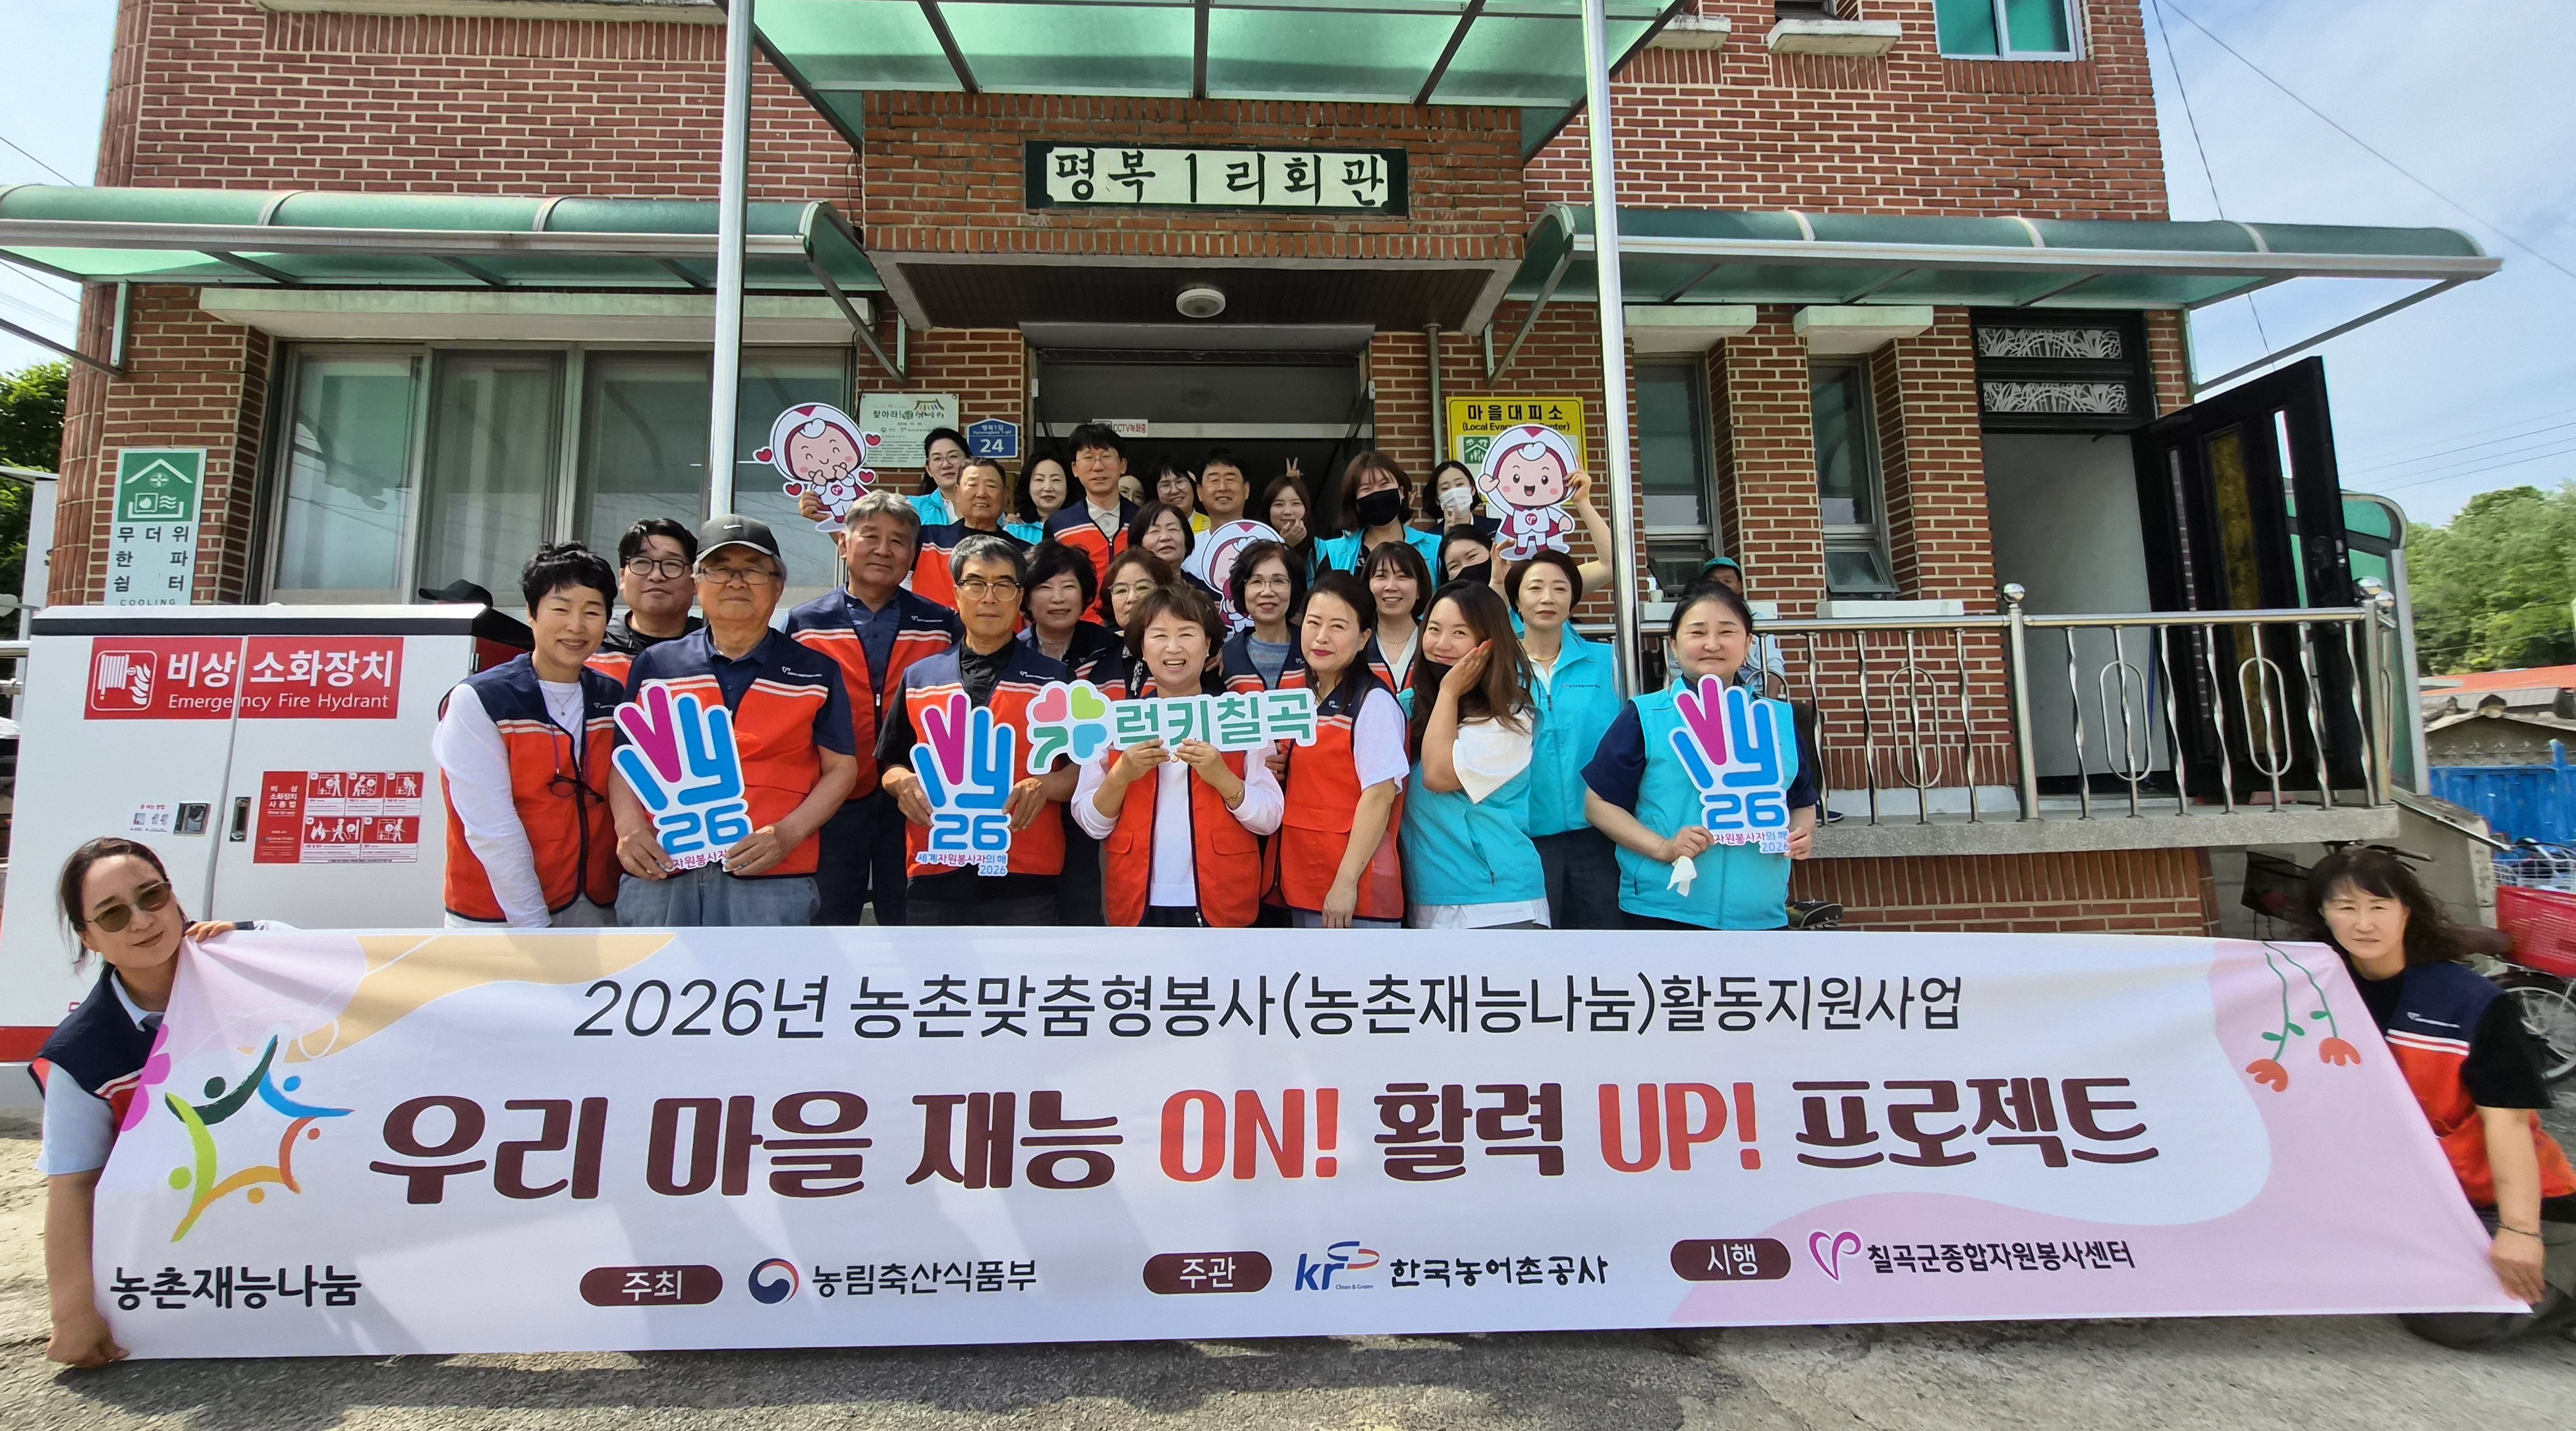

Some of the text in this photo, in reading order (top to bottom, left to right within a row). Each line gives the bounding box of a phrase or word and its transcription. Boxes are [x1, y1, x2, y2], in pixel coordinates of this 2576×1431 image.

[872, 410, 901, 419] 찾아라!
[1462, 422, 1488, 432] (Local
[1467, 404, 1563, 421] 마을대피소
[980, 438, 1004, 453] 24
[117, 526, 189, 543] 무더위
[115, 550, 188, 567] 한파
[113, 575, 184, 592] 쉼터
[167, 650, 393, 688] 비상 소화장치
[169, 692, 389, 712] Emergency Fire Hydrant
[1115, 693, 1312, 746] 럭키칠곡
[1704, 791, 1785, 830] 26
[659, 803, 749, 855] 26
[933, 814, 1008, 851] 26
[997, 855, 1007, 864] 해
[1762, 842, 1789, 852] 2026
[980, 865, 1006, 874] 2026
[573, 970, 1962, 1040] 2026년 농촌맞춤형봉사(농촌재능나눔)활동지원사업
[369, 1077, 2160, 1204] 우리 마을 재능 ON! 활력 UP! 프로젝트
[1179, 1256, 1237, 1289] 주관
[1389, 1254, 1609, 1289] 한국농어촌공사
[1706, 1243, 1758, 1276] 시행
[1866, 1240, 2136, 1275] 칠곡군종합자원봉사센터
[109, 1264, 363, 1311] 농촌재능나눔
[621, 1270, 683, 1301] 주최
[812, 1259, 1037, 1299] 농림축산식품부
